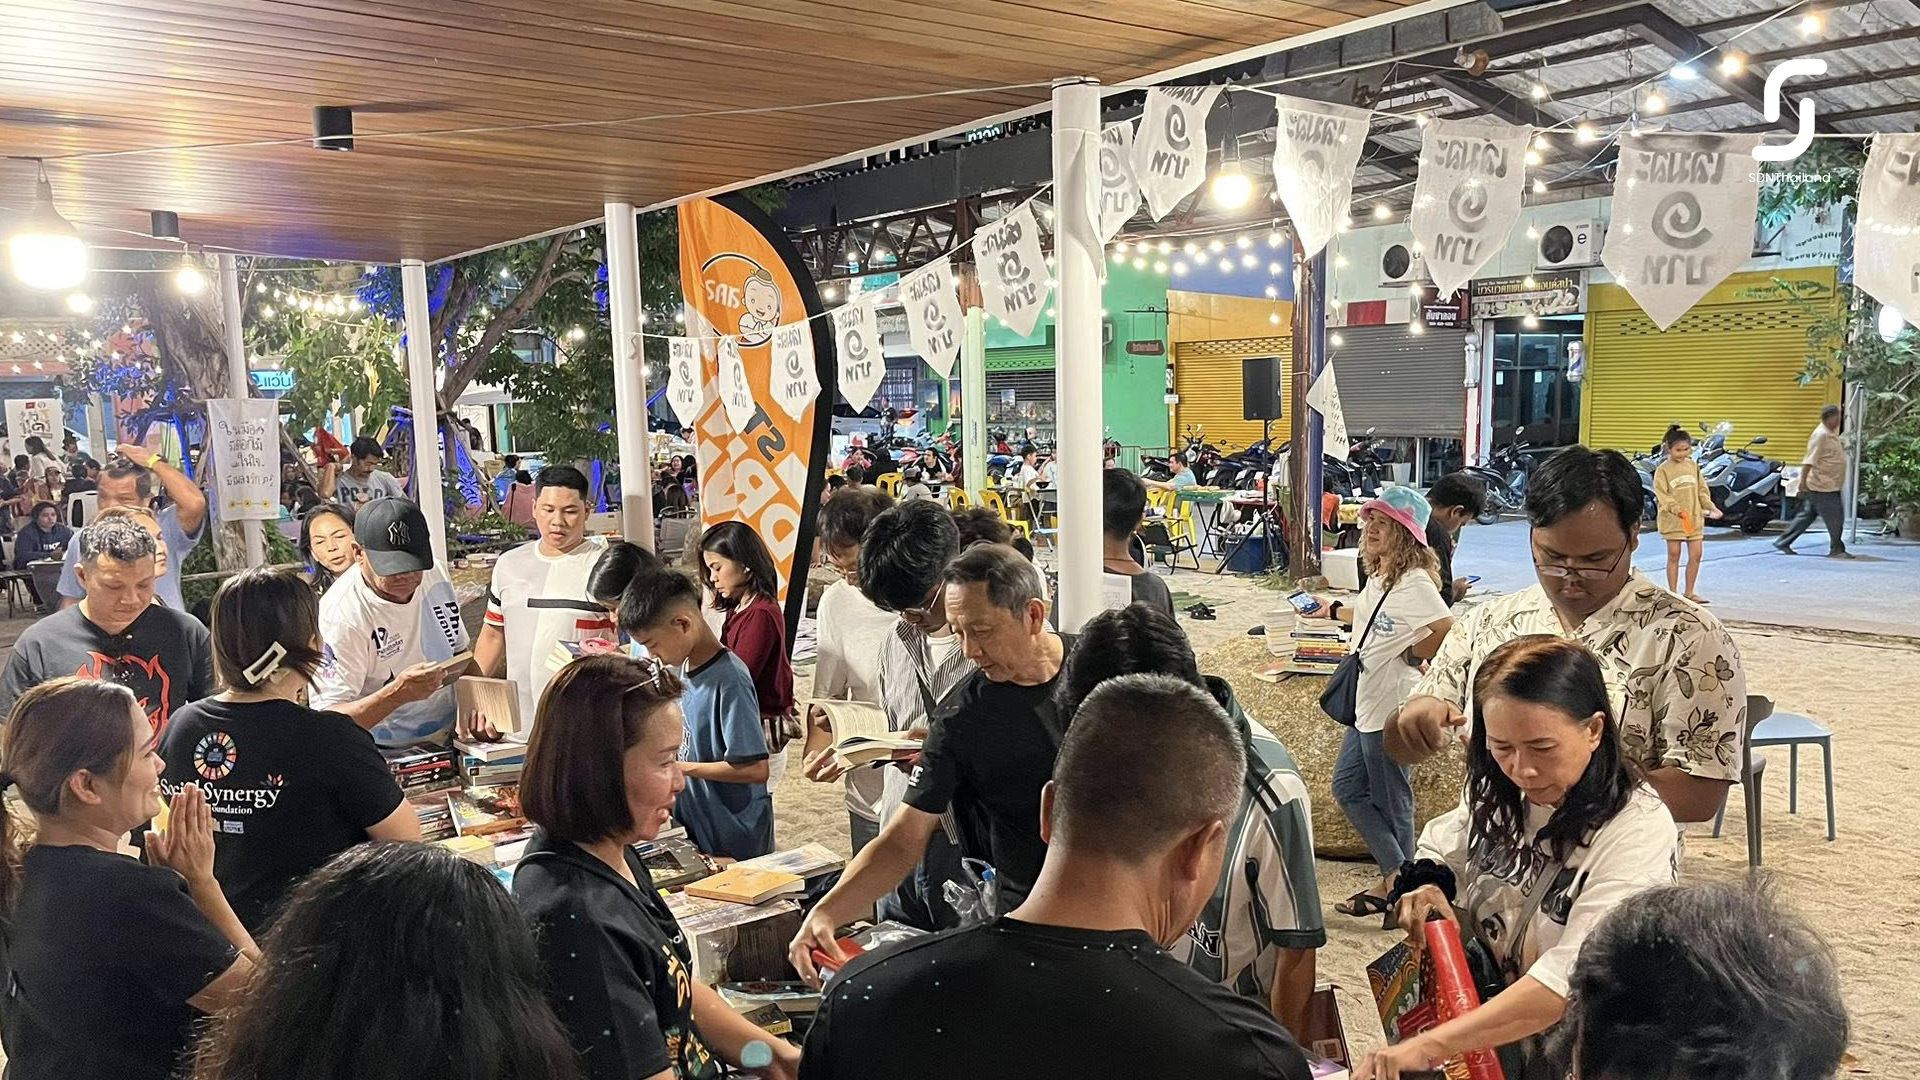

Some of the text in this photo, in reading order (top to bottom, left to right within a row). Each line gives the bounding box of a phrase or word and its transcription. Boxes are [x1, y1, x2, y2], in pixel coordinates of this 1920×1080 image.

[160, 777, 281, 809] Socil Synergy
[209, 805, 254, 815] oundation
